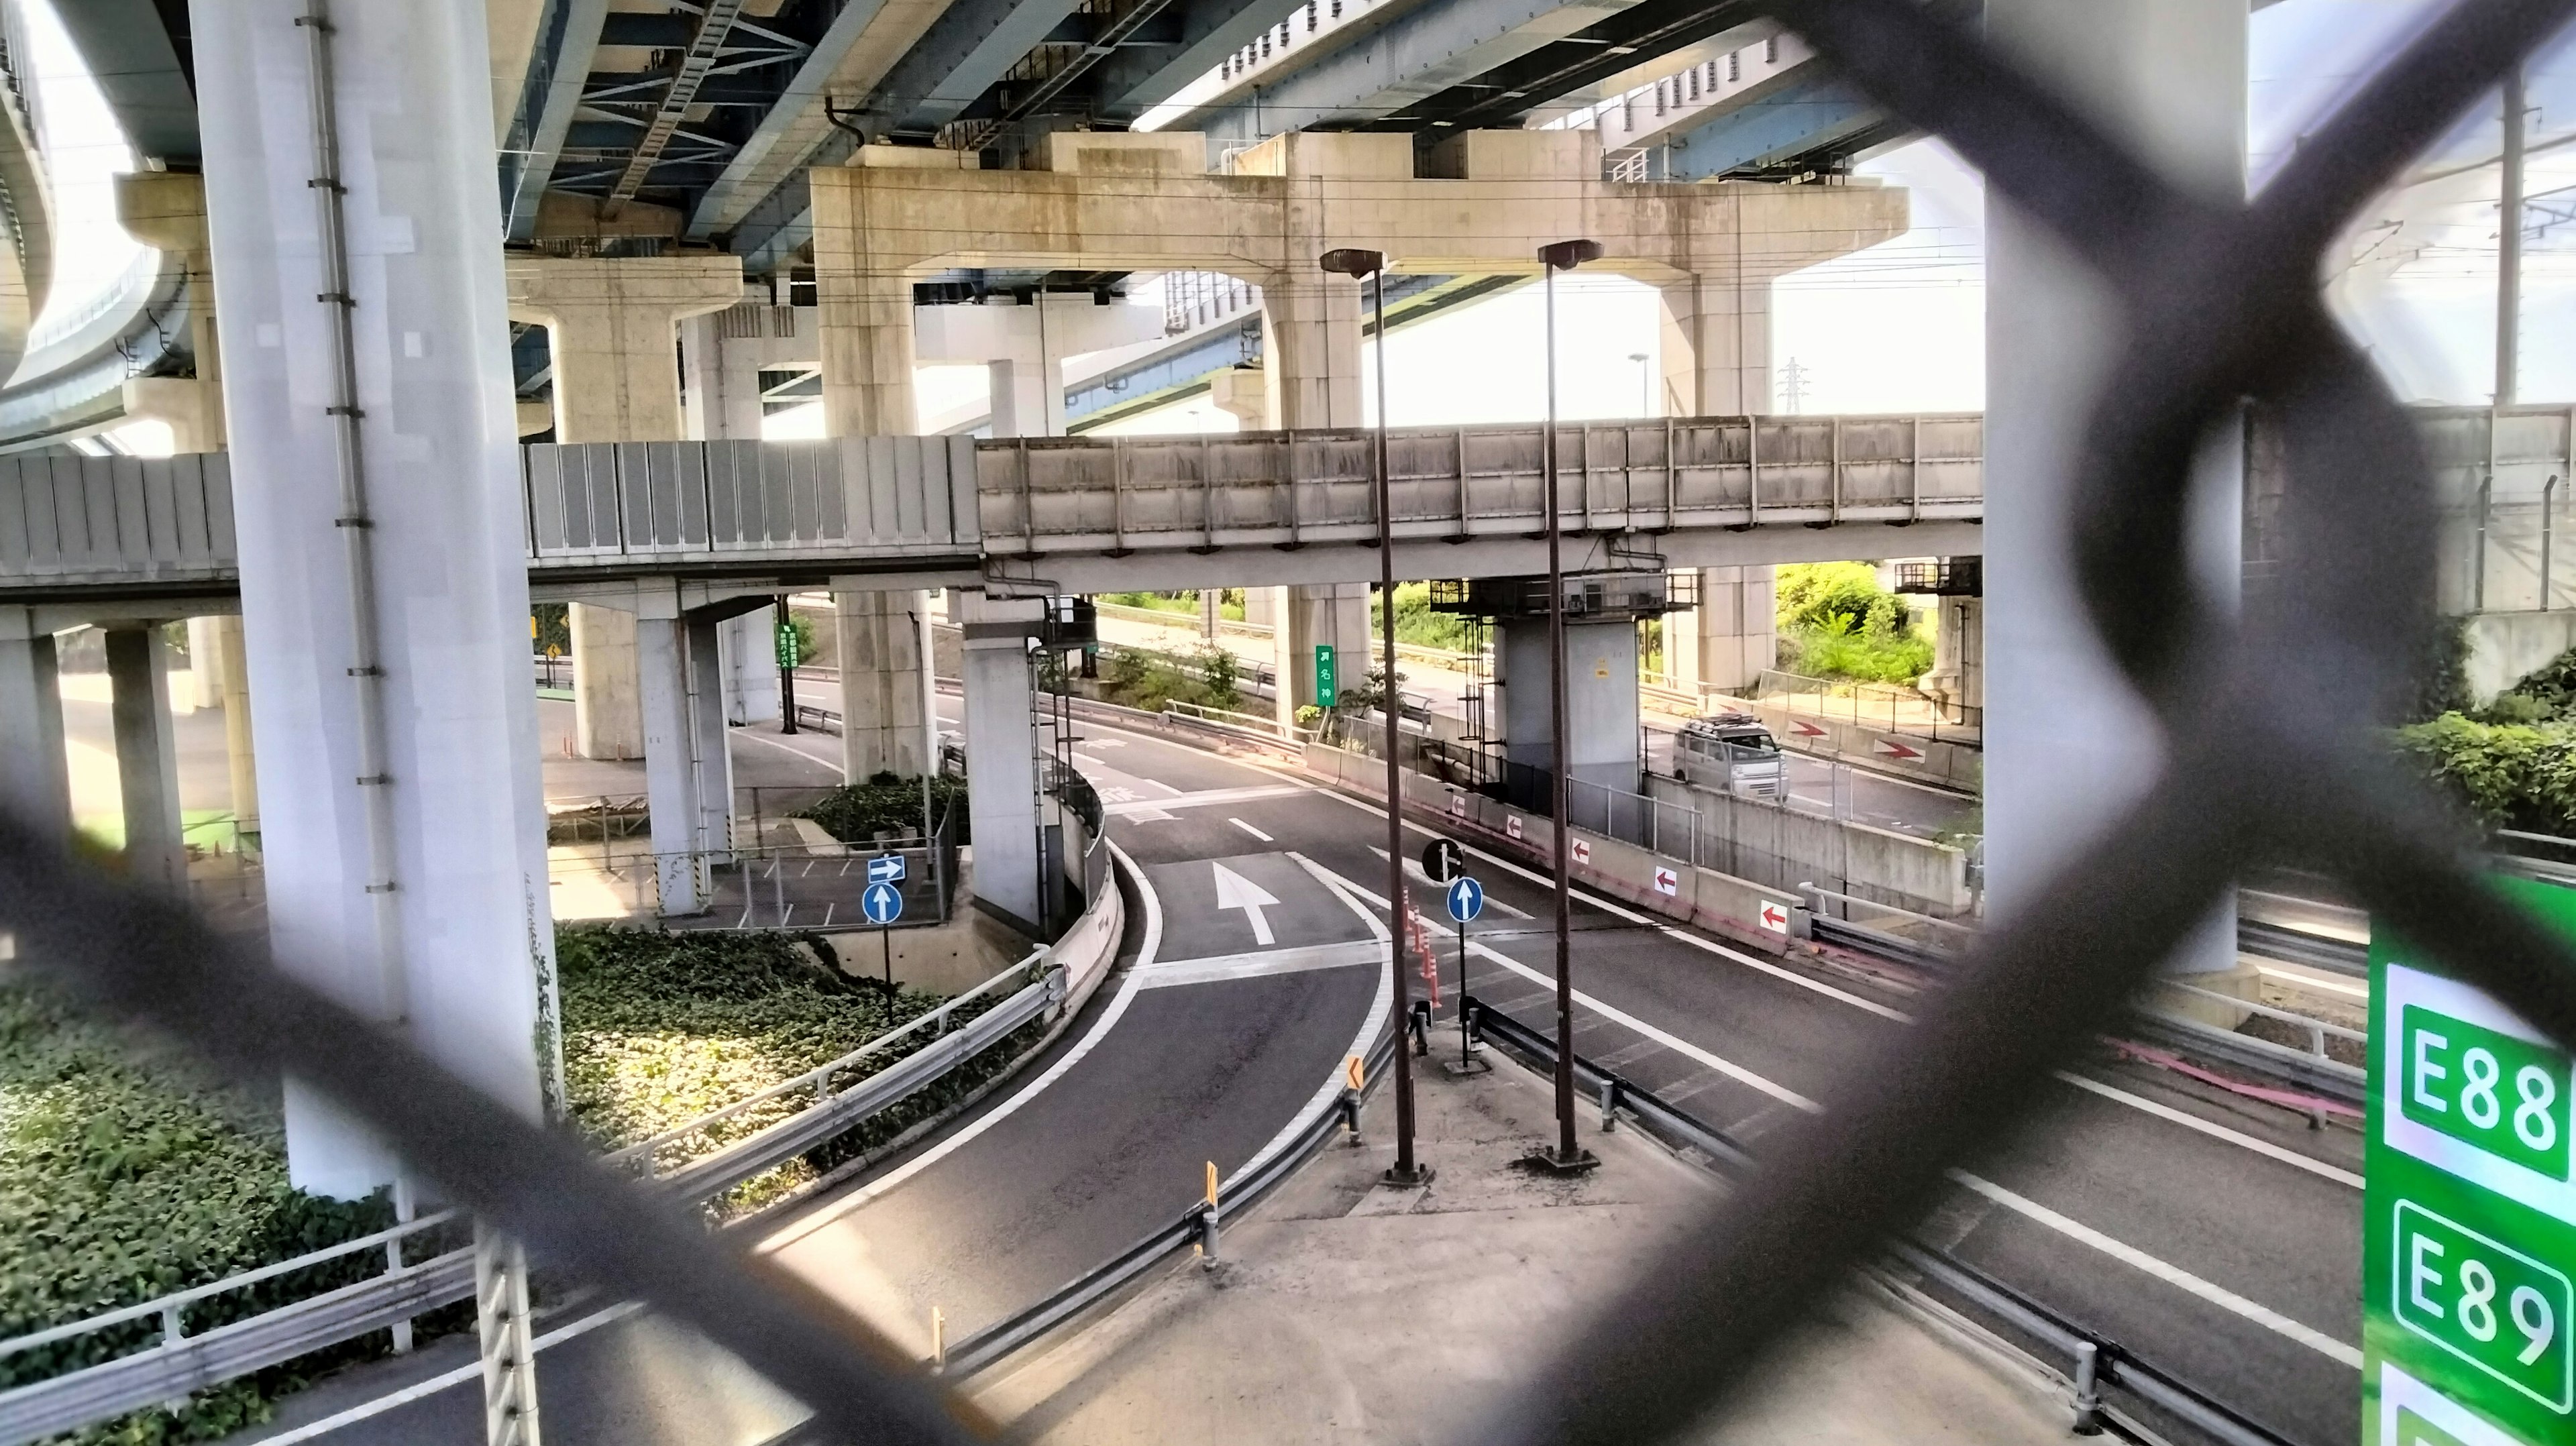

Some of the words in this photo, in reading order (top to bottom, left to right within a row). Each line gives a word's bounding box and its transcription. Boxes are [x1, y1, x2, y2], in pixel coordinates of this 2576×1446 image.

[1320, 669, 1331, 698] 名神
[2414, 1027, 2557, 1152] E88
[2411, 1231, 2555, 1366] E89
